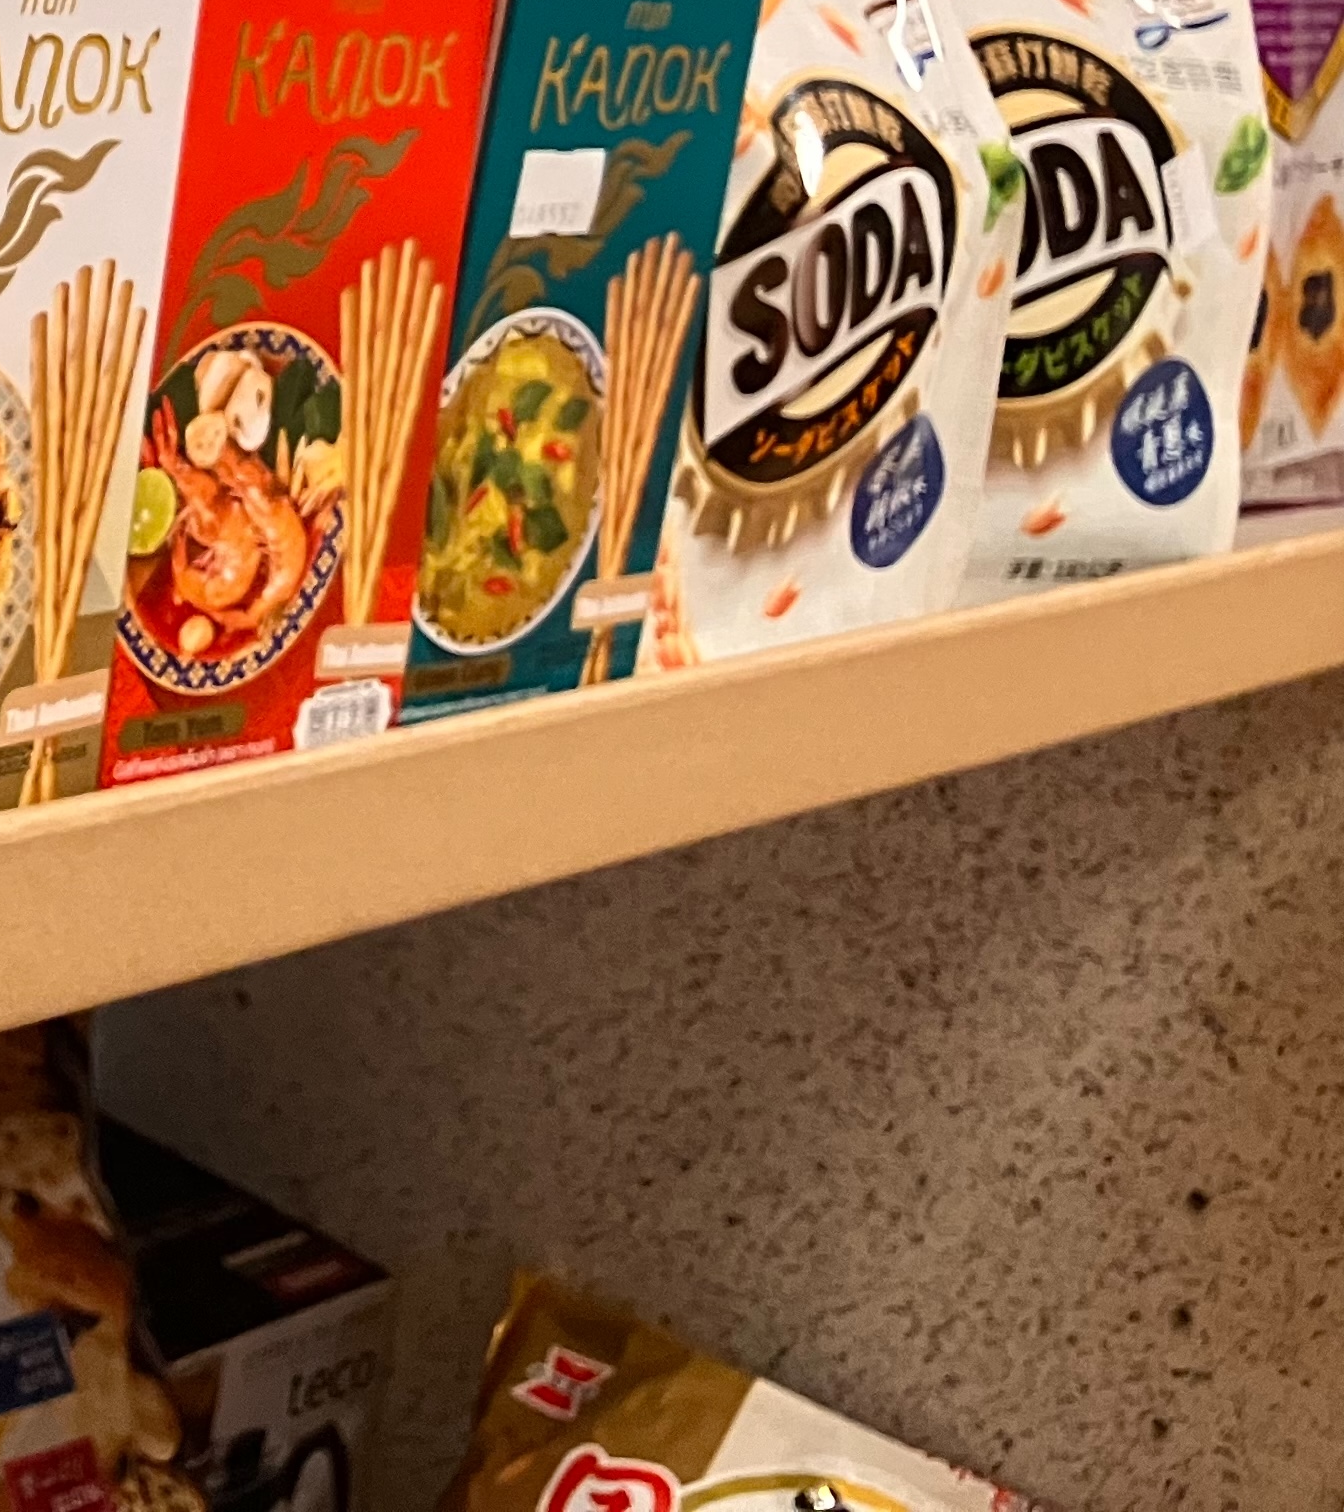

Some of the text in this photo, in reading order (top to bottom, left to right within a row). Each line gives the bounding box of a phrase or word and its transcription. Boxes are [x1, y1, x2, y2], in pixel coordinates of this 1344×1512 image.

[226, 19, 459, 126] KANOK
[530, 34, 732, 133] KANOK
[1015, 129, 1156, 279] DA
[728, 181, 934, 395] SODA
